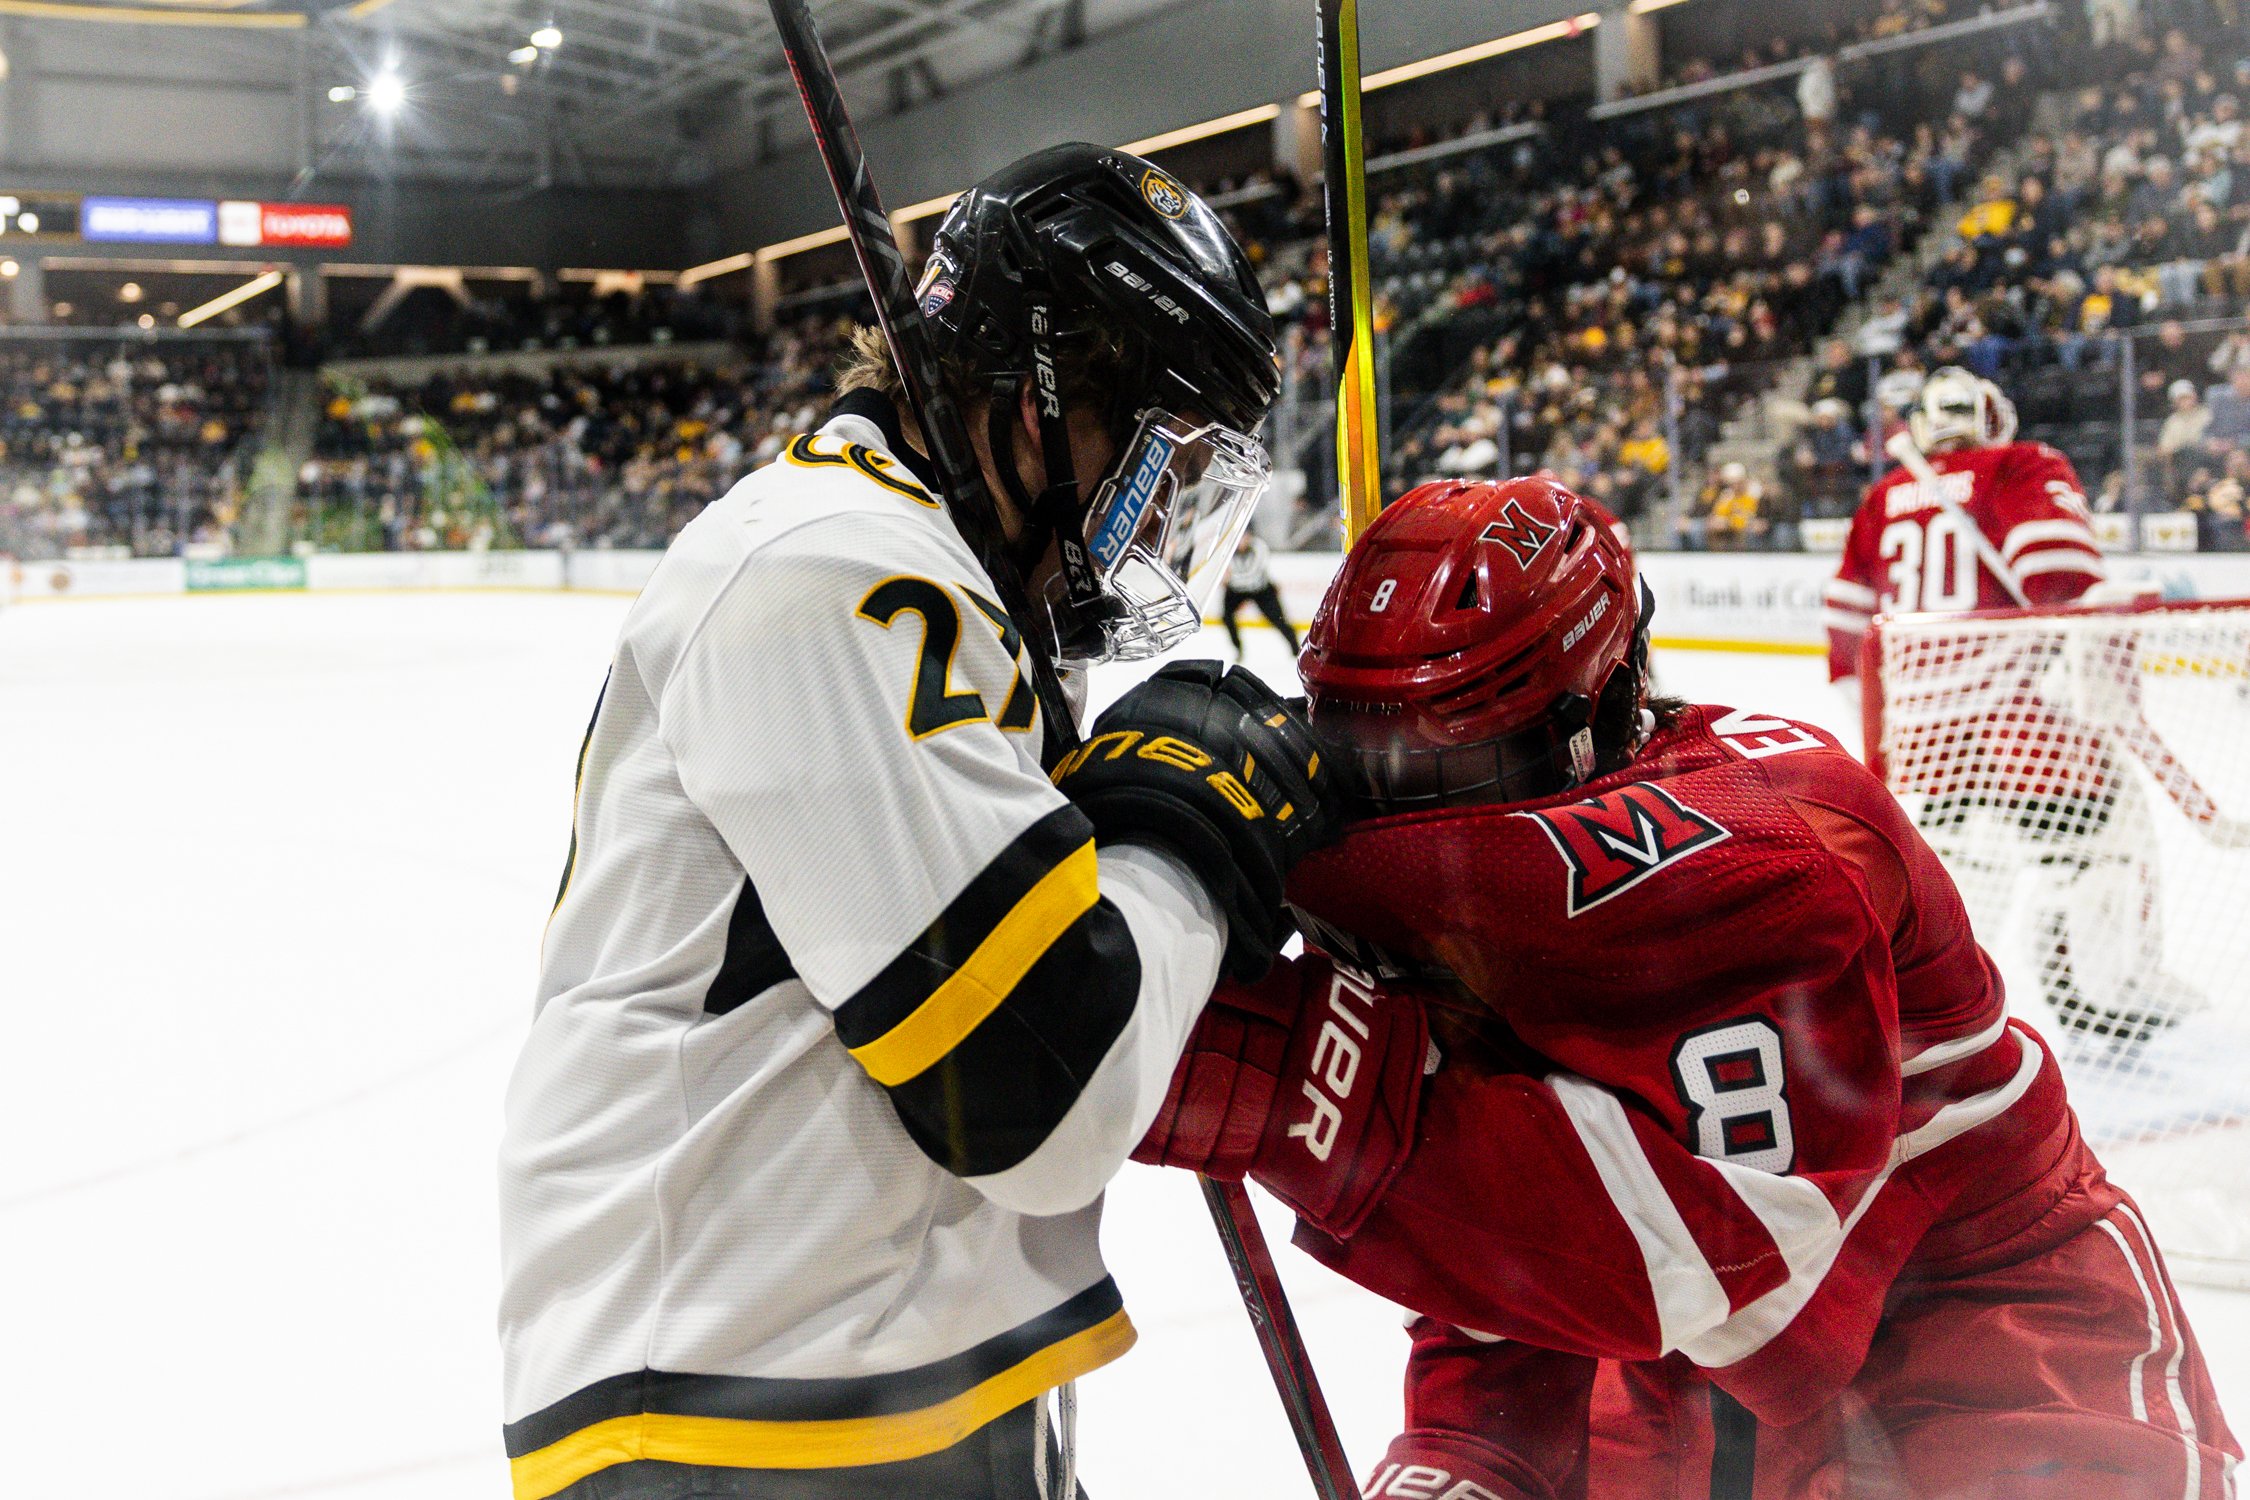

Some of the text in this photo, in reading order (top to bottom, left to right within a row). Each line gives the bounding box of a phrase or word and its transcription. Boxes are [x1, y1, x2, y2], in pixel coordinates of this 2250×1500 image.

[1098, 438, 1166, 562] BAUER
[1878, 510, 1979, 611] 30
[854, 573, 1040, 742] 27
[1369, 578, 1398, 613] 8
[1562, 591, 1611, 652] BAUER
[1504, 781, 1733, 919] M
[1667, 1011, 1797, 1177] 8
